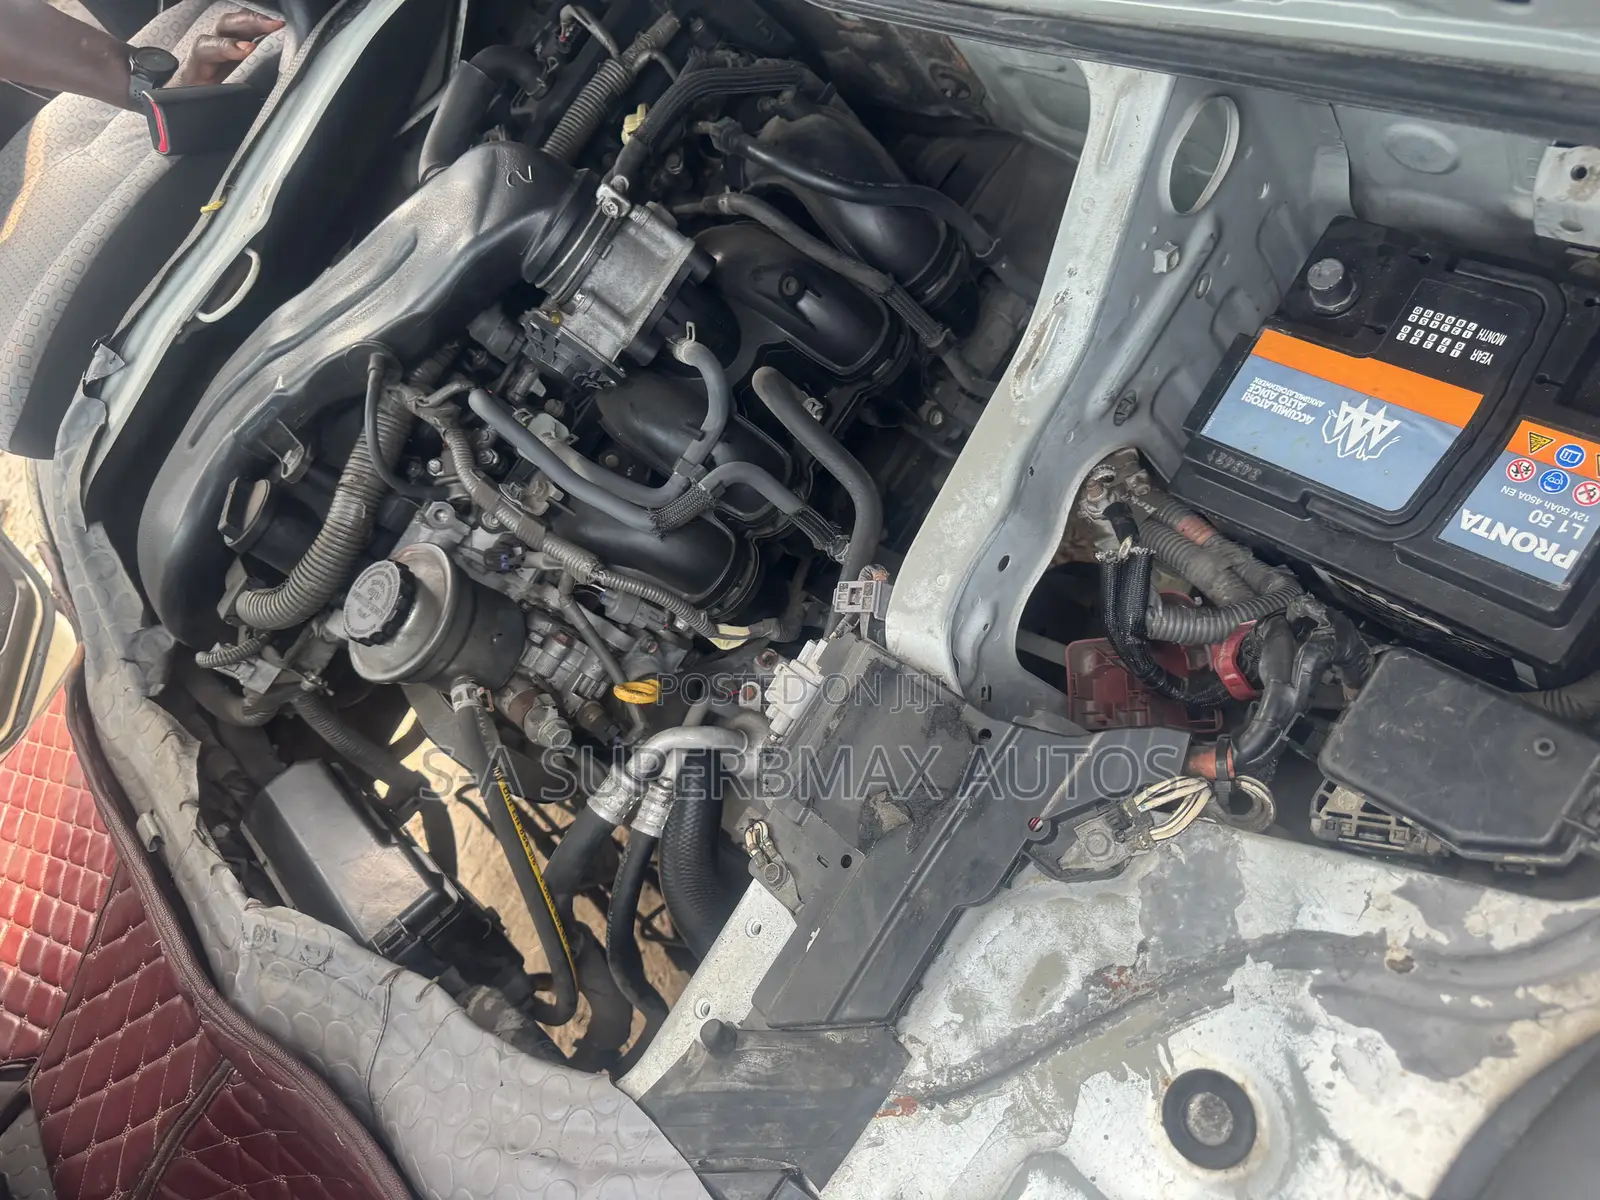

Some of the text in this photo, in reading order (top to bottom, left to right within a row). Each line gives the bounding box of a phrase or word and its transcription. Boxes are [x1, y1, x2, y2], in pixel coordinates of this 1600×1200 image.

[1476, 328, 1508, 346] MONTH
[1470, 349, 1494, 365] YEAR
[1241, 391, 1316, 425] ACCUMULATORI
[1246, 383, 1306, 411] ALTO ADIGE
[1500, 485, 1591, 523] 12V 50Ah 450A EN
[1460, 508, 1579, 569] PRONTA
[1528, 509, 1586, 540] L1 50
